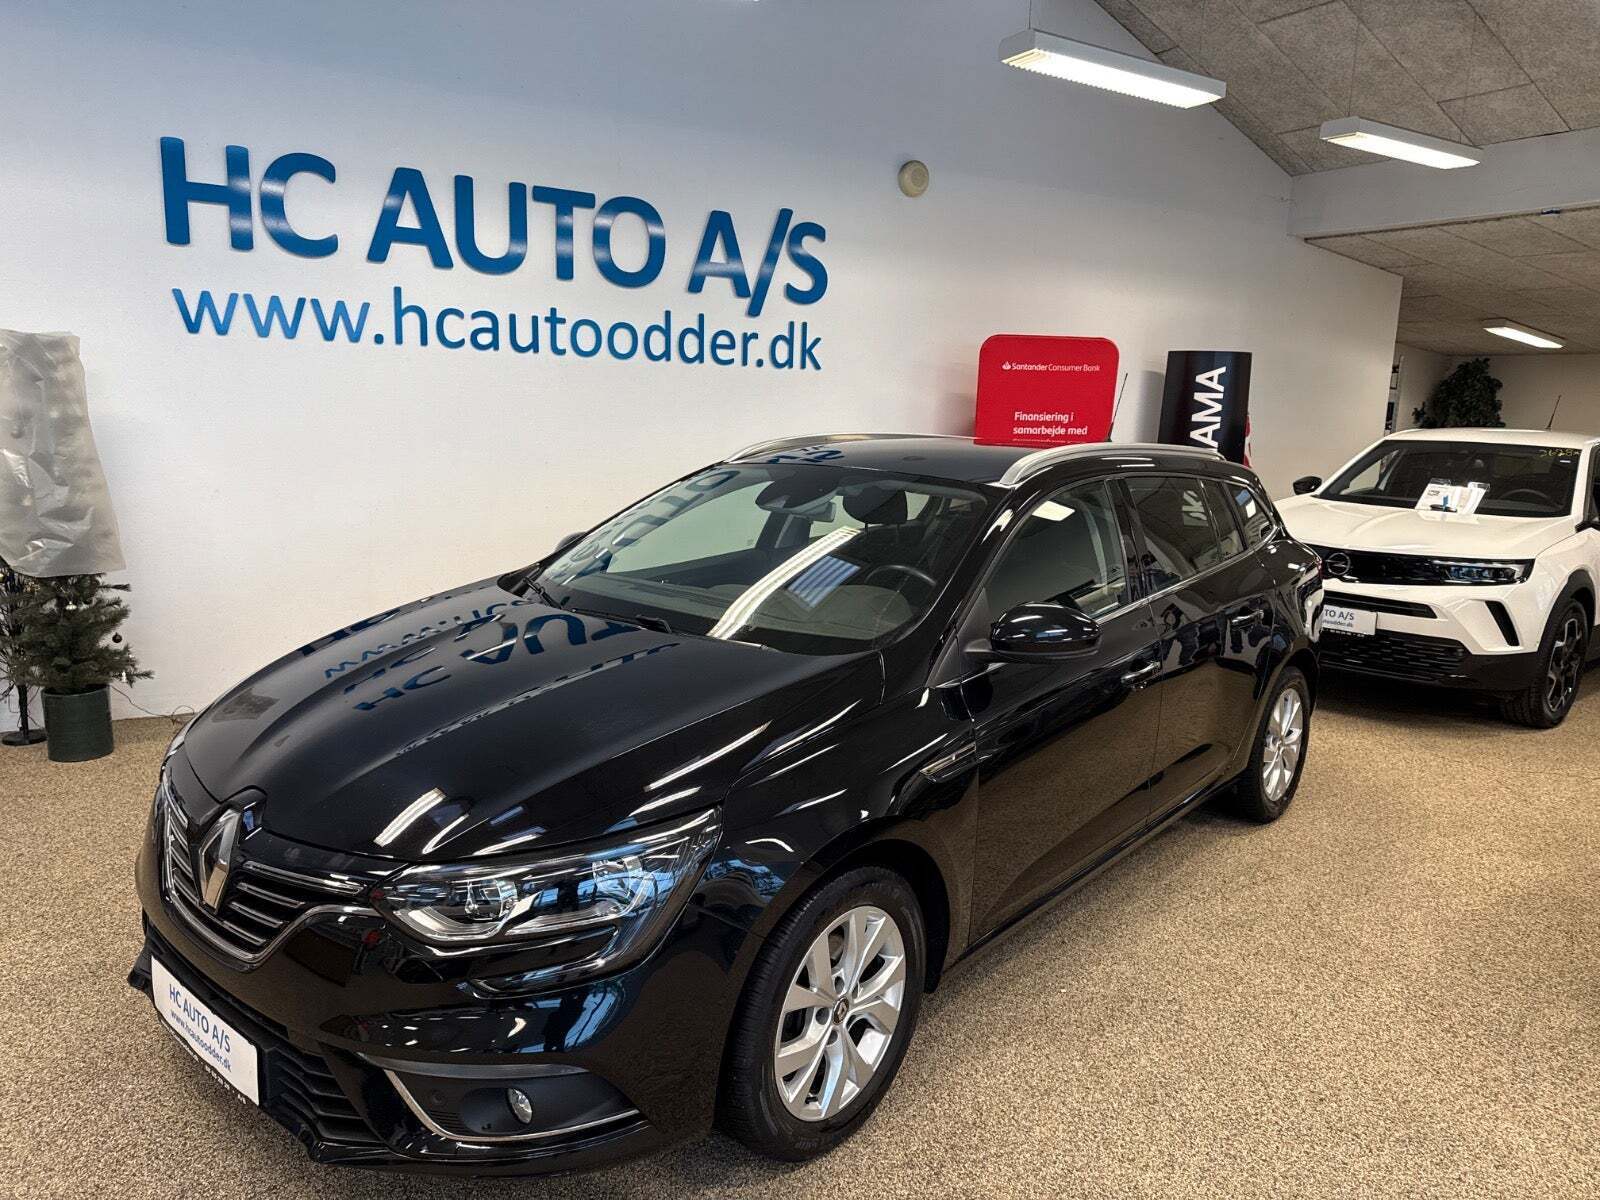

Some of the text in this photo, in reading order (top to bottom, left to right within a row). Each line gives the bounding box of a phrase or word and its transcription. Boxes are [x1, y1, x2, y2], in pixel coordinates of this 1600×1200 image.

[160, 136, 828, 317] HC AUTO A/S
[172, 287, 822, 370] www.hcautoodder.dk
[1011, 362, 1100, 372] Santander Consumer Bank
[1012, 425, 1088, 437] samarbejde med
[1014, 411, 1070, 424] Finansiering
[1189, 366, 1227, 452] AMA
[1324, 609, 1354, 621] TO A/S
[169, 983, 182, 1009] HC
[183, 998, 210, 1035] AUTO
[212, 1024, 231, 1053] A/S
[170, 1010, 232, 1073] www.hcautoodder.dk
